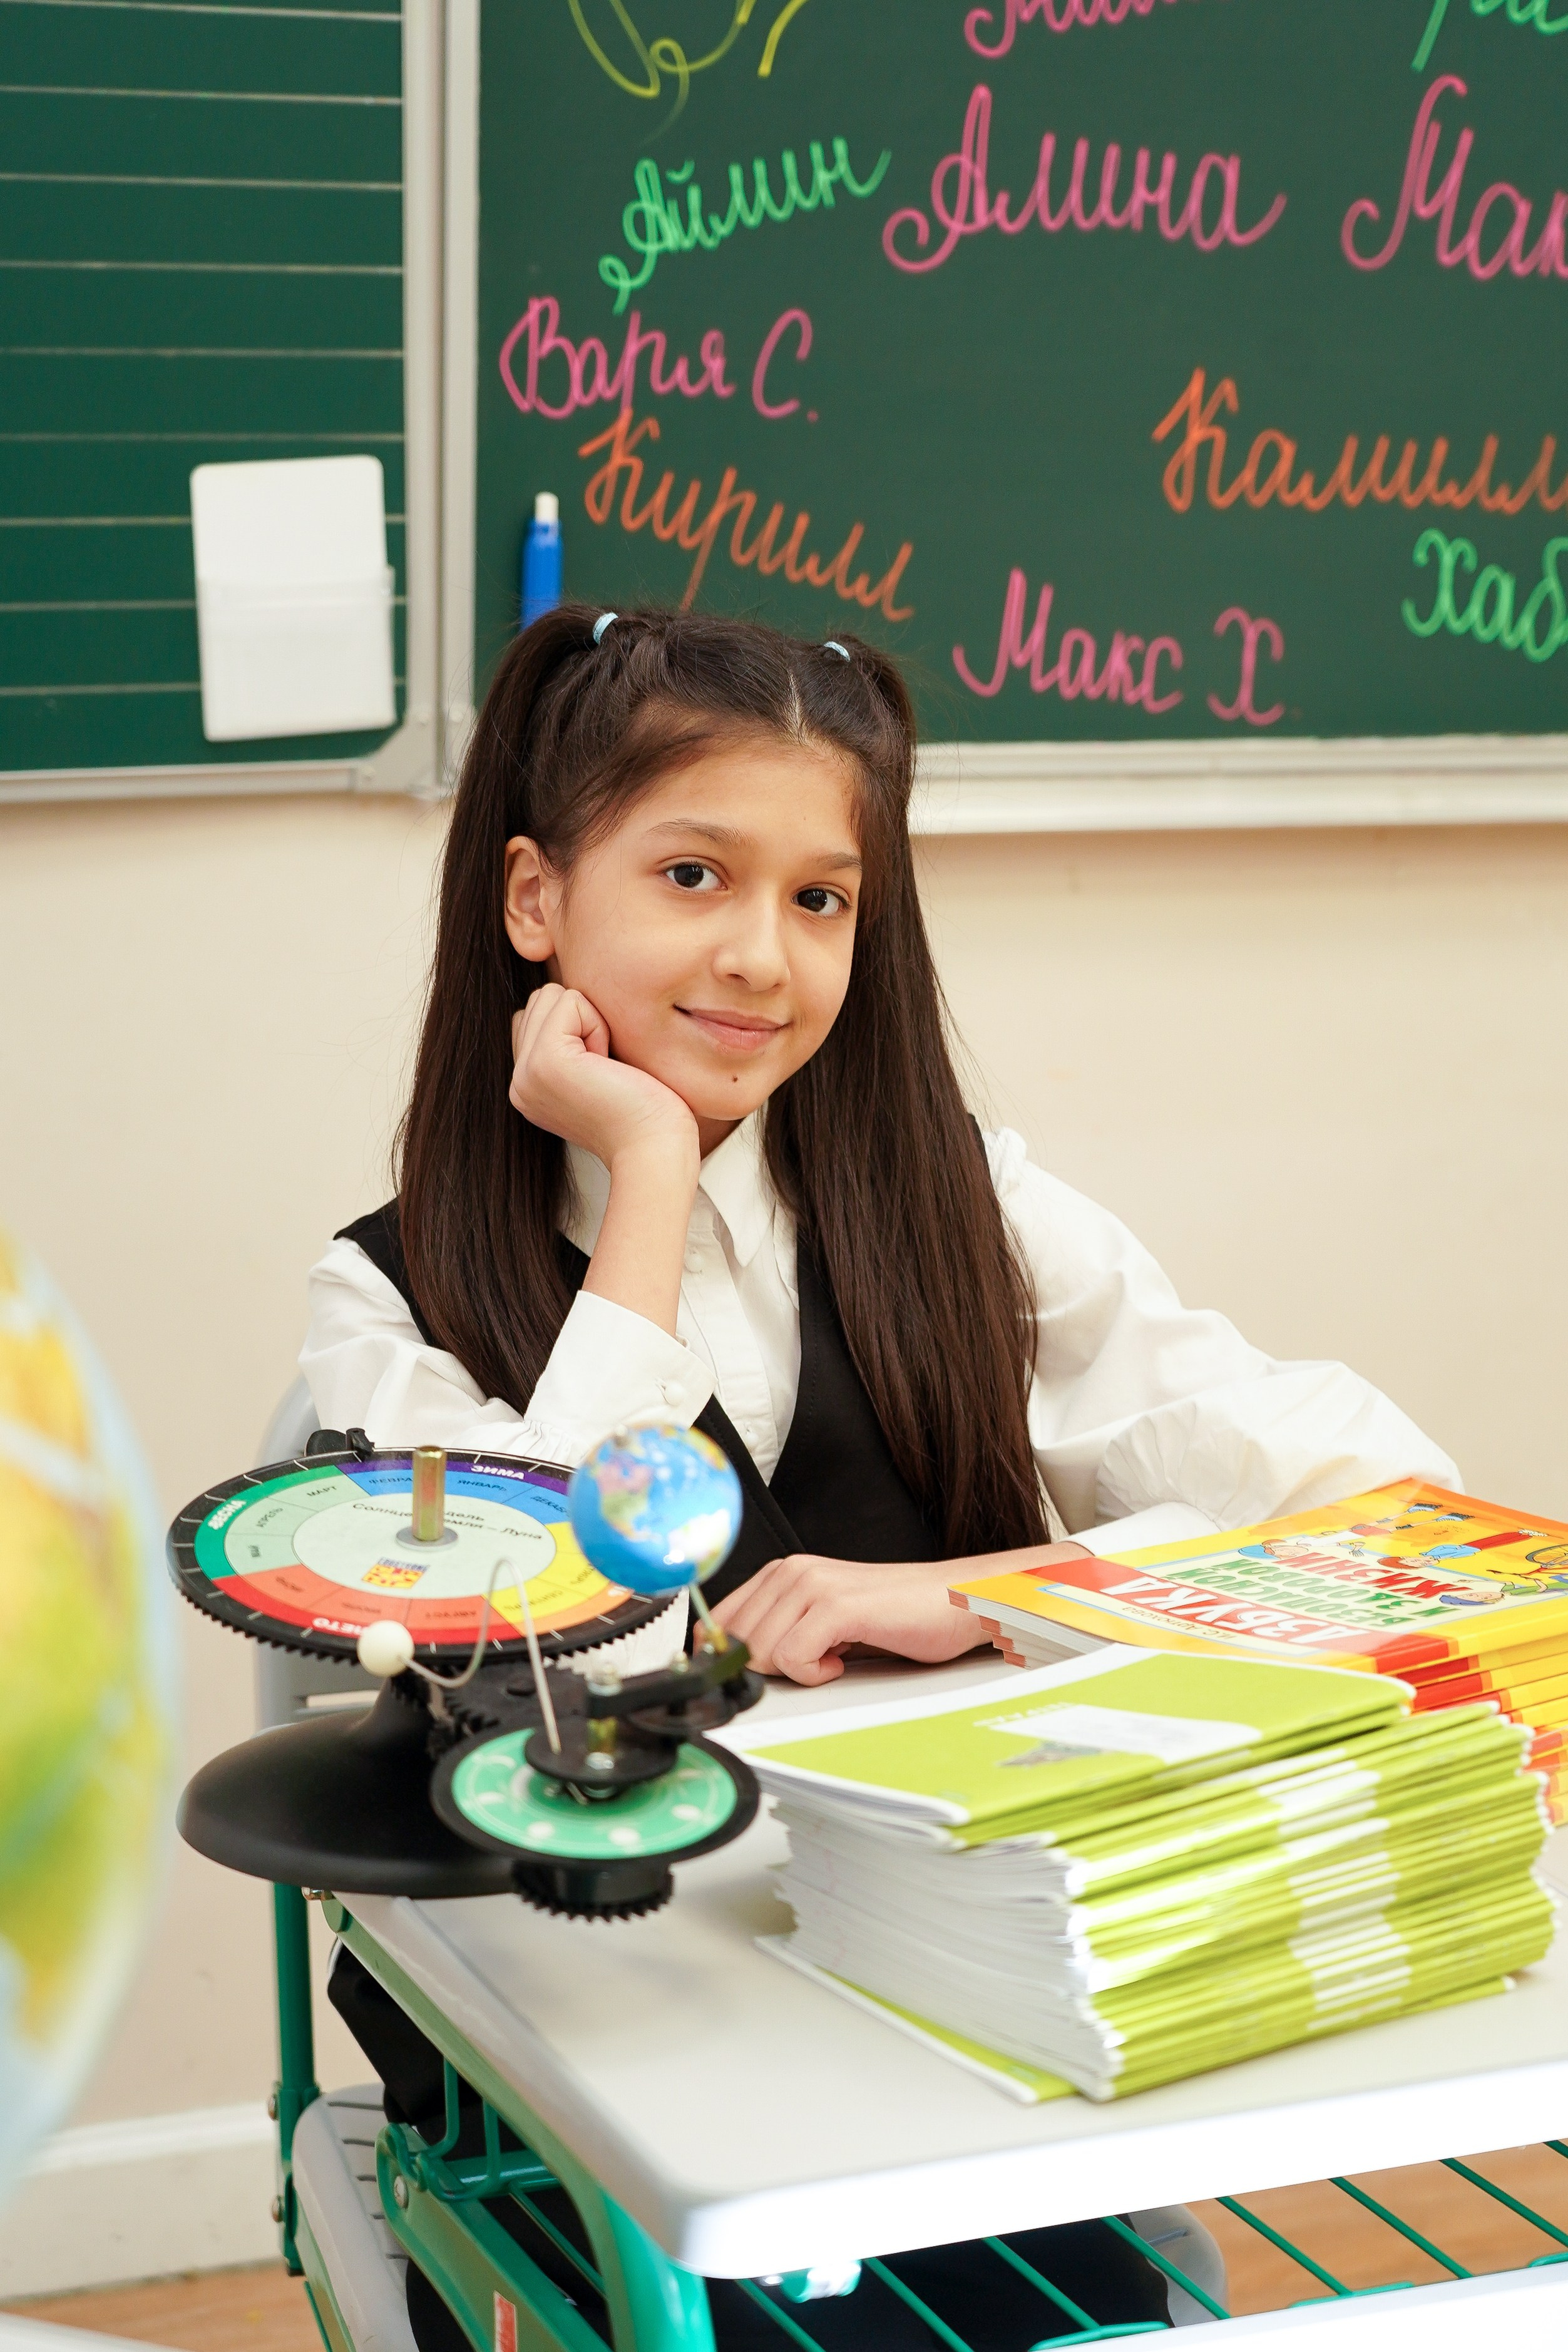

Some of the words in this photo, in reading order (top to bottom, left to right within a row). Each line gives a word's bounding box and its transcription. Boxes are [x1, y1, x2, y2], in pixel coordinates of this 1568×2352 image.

[881, 83, 1288, 274] Алина
[499, 295, 737, 421] Варя
[1150, 366, 1568, 515] Камилл
[952, 565, 1186, 715] Макс
[368, 1477, 414, 1486] ФЕВРА
[456, 1478, 508, 1492] ЯНВАРЬ
[470, 1463, 525, 1481] ЗИМА
[305, 1484, 338, 1497] МАРТ
[530, 1494, 569, 1517] ДЕКАБ
[442, 1511, 485, 1522] дель
[442, 1518, 484, 1529] емля
[500, 1526, 543, 1540] Луна
[1205, 1558, 1423, 1610] ЗДОРОВОЙ
[1271, 1551, 1473, 1599] ЖИЗНИ
[1099, 1575, 1371, 1645] АЗБУКА
[1158, 1567, 1416, 1627] БЕЗОПАСНОЙ
[1408, 1606, 1462, 1618] И
